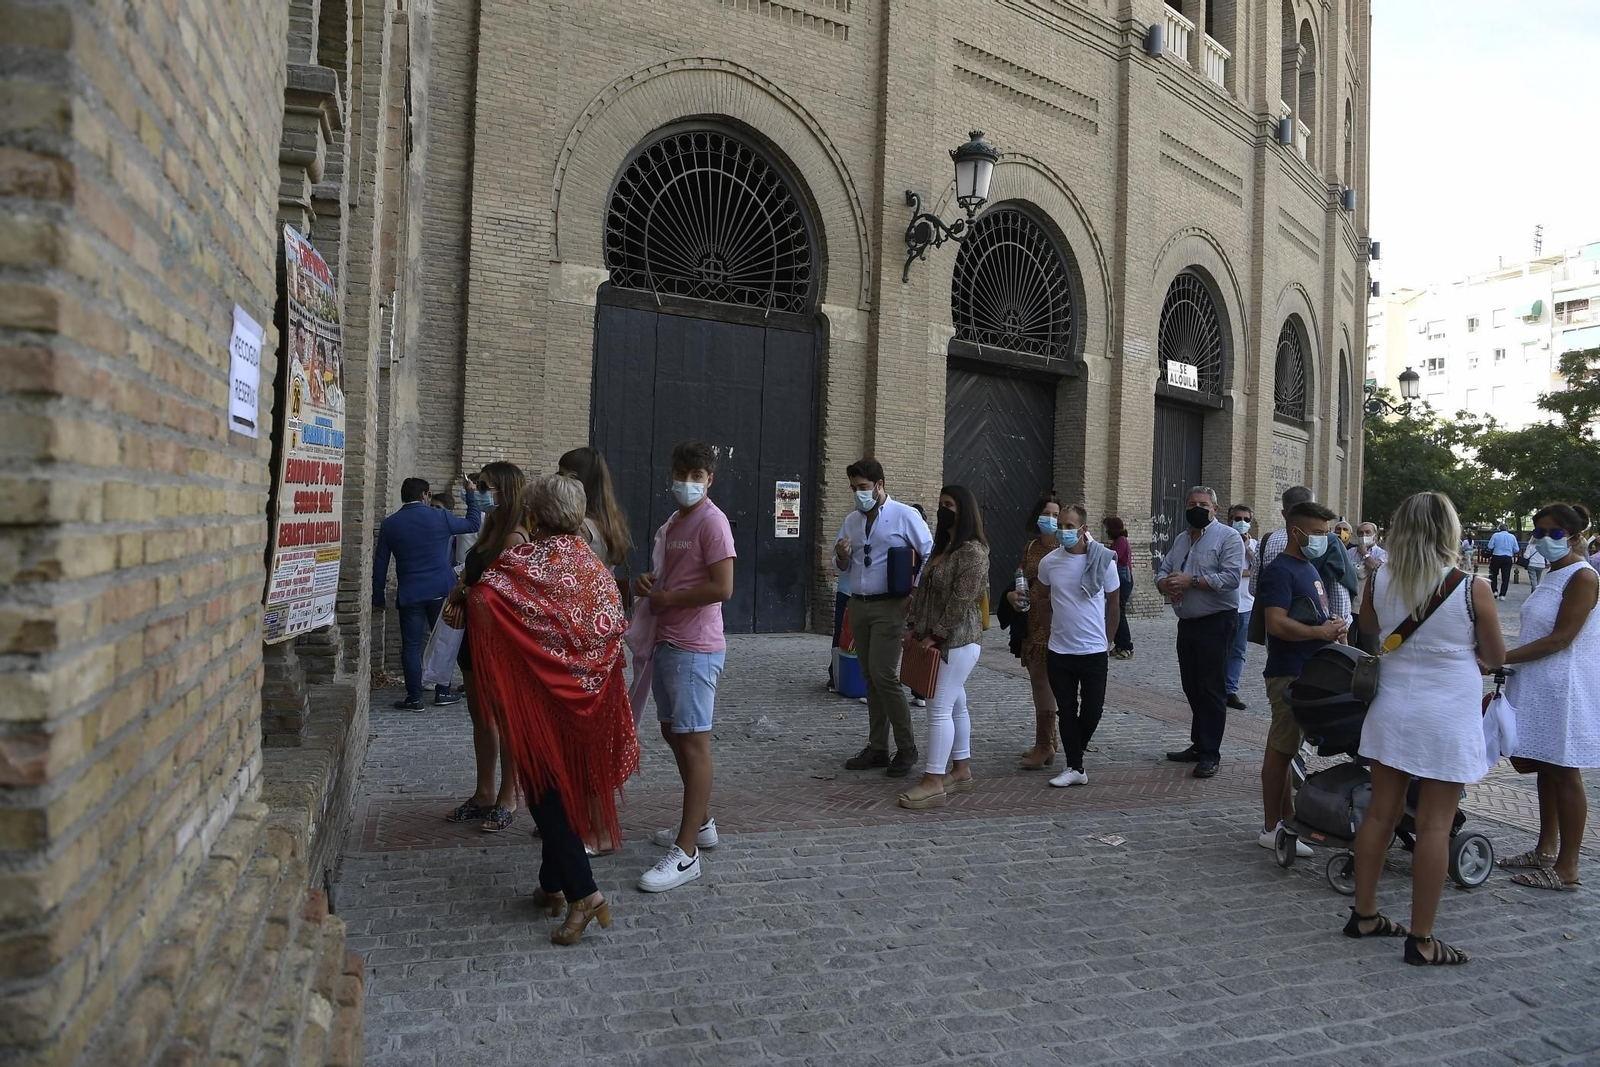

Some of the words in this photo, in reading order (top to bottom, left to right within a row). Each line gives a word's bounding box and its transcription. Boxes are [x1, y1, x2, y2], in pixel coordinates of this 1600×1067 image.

[1170, 372, 1197, 389] ALQUILA
[1180, 364, 1187, 375] SE
[285, 458, 320, 487] ENRIQUE
[320, 461, 342, 486] PONCE
[294, 490, 318, 514] CURRO
[318, 488, 333, 514] DÍAZ
[278, 518, 315, 548] SEBASTIÁN
[315, 521, 341, 544] CASTELLA
